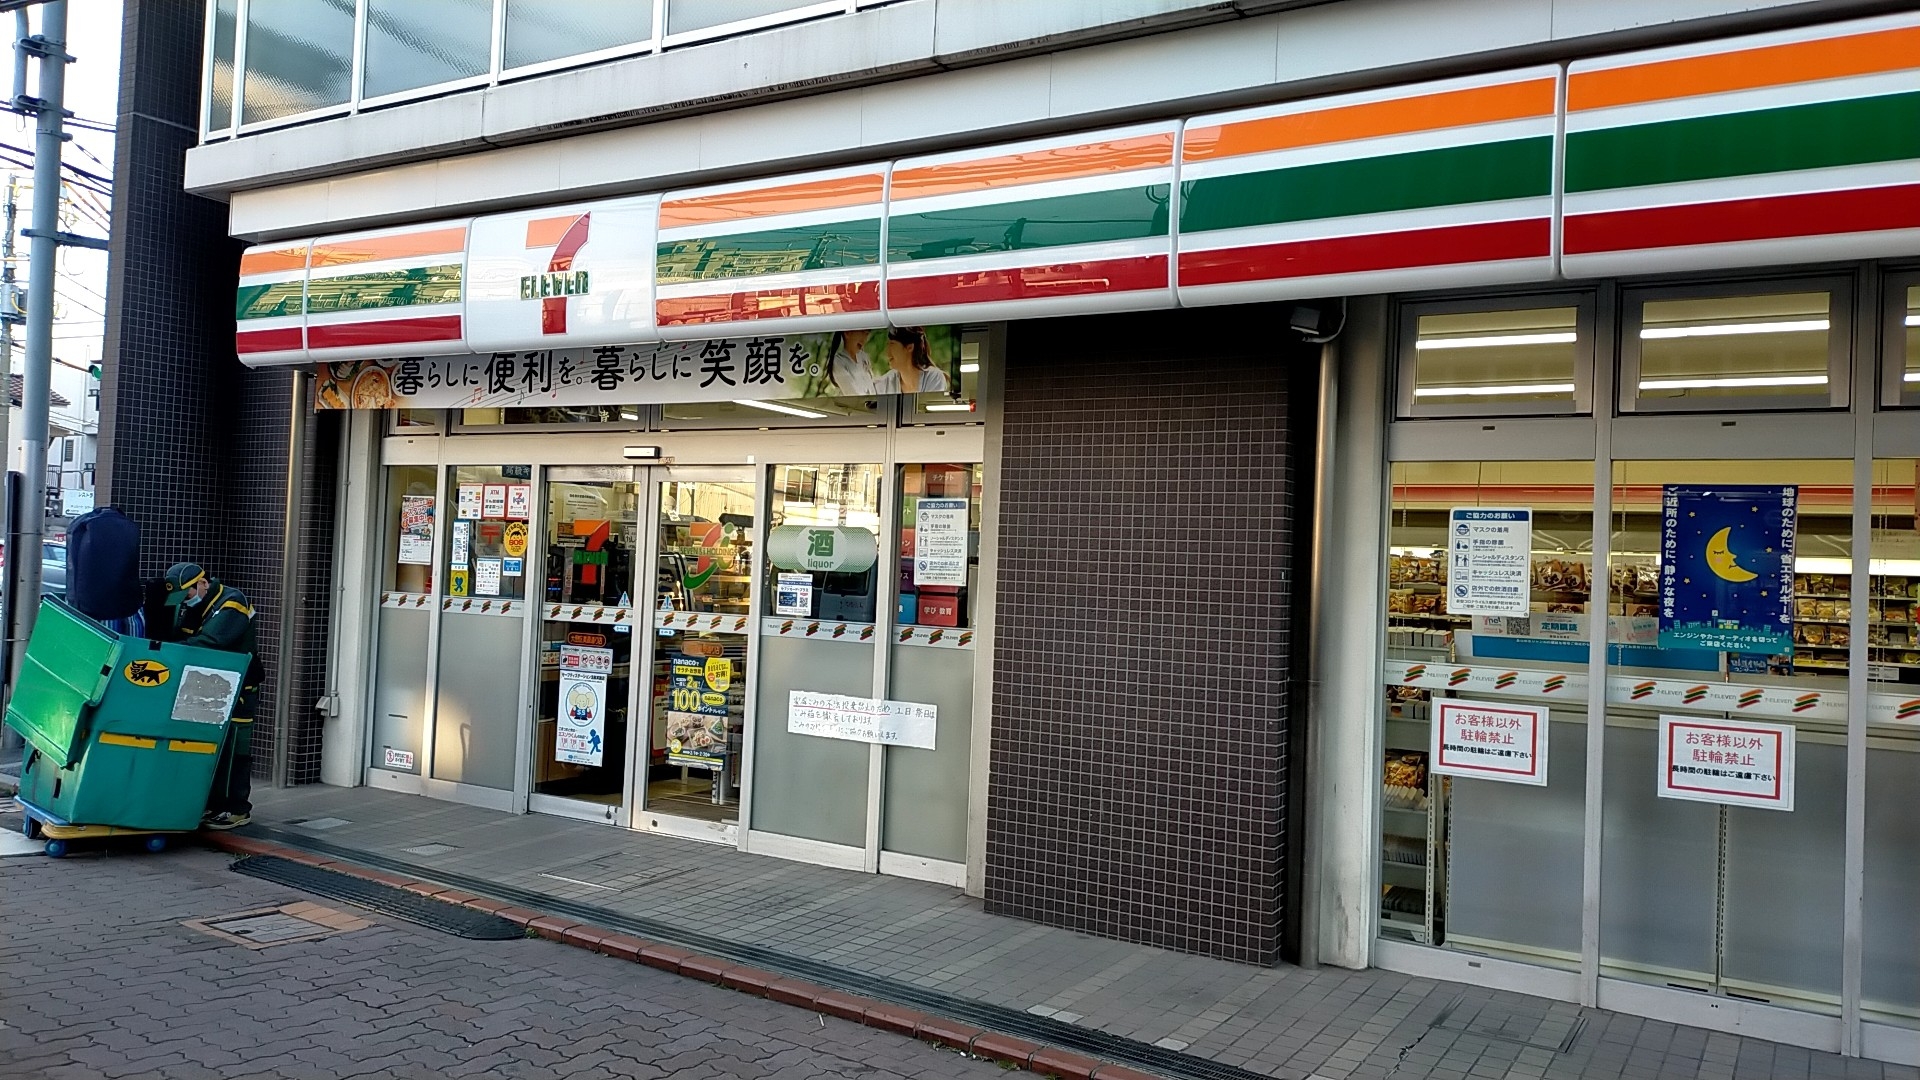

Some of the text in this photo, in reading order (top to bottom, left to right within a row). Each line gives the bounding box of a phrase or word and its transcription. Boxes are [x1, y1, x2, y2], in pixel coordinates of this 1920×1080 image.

[1465, 512, 1516, 520] ご協力のお願い
[808, 529, 835, 557] 酒
[1663, 486, 1679, 618] ご近所のために、静かな夜を
[807, 559, 834, 569] liquor
[1778, 486, 1795, 624] 地球のために、省エネルギーを
[1673, 631, 1778, 644] エンジンやカーオーディオを切って
[672, 688, 700, 712] 100
[1454, 712, 1522, 730] お客様以外
[1460, 729, 1516, 745] 駐輪禁止
[1685, 731, 1764, 750] お客様以外
[1443, 743, 1533, 759] 長時間の駐輪はご遠慮下さい
[1692, 749, 1756, 767] 駐輪禁止
[1671, 764, 1776, 782] 長時間の駐輪はご遠慮下さい
